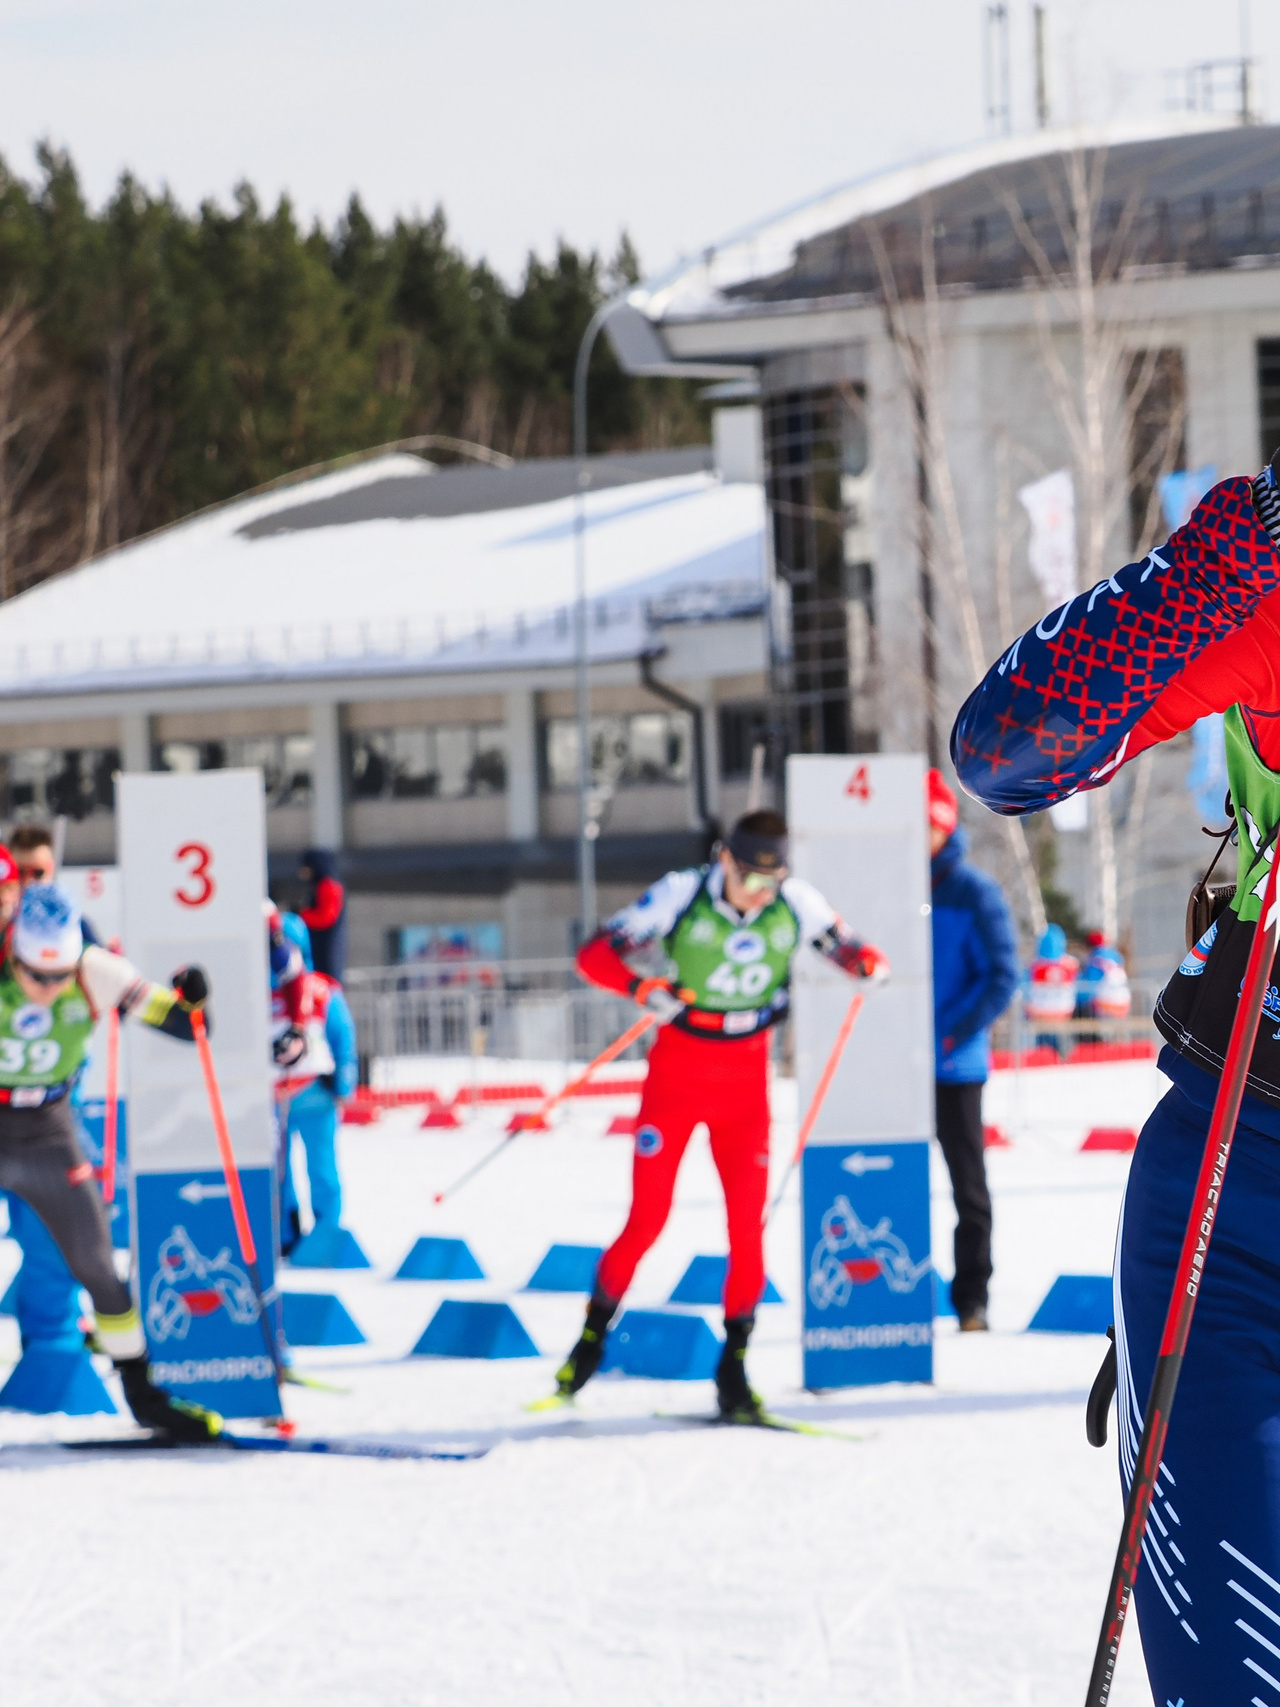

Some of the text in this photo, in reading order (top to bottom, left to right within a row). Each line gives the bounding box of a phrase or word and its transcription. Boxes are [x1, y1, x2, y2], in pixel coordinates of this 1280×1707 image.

[846, 764, 871, 803] 4
[175, 844, 214, 906] 3
[705, 962, 772, 998] 40
[0, 1037, 61, 1075] 39
[1207, 1142, 1230, 1204] TRIAC
